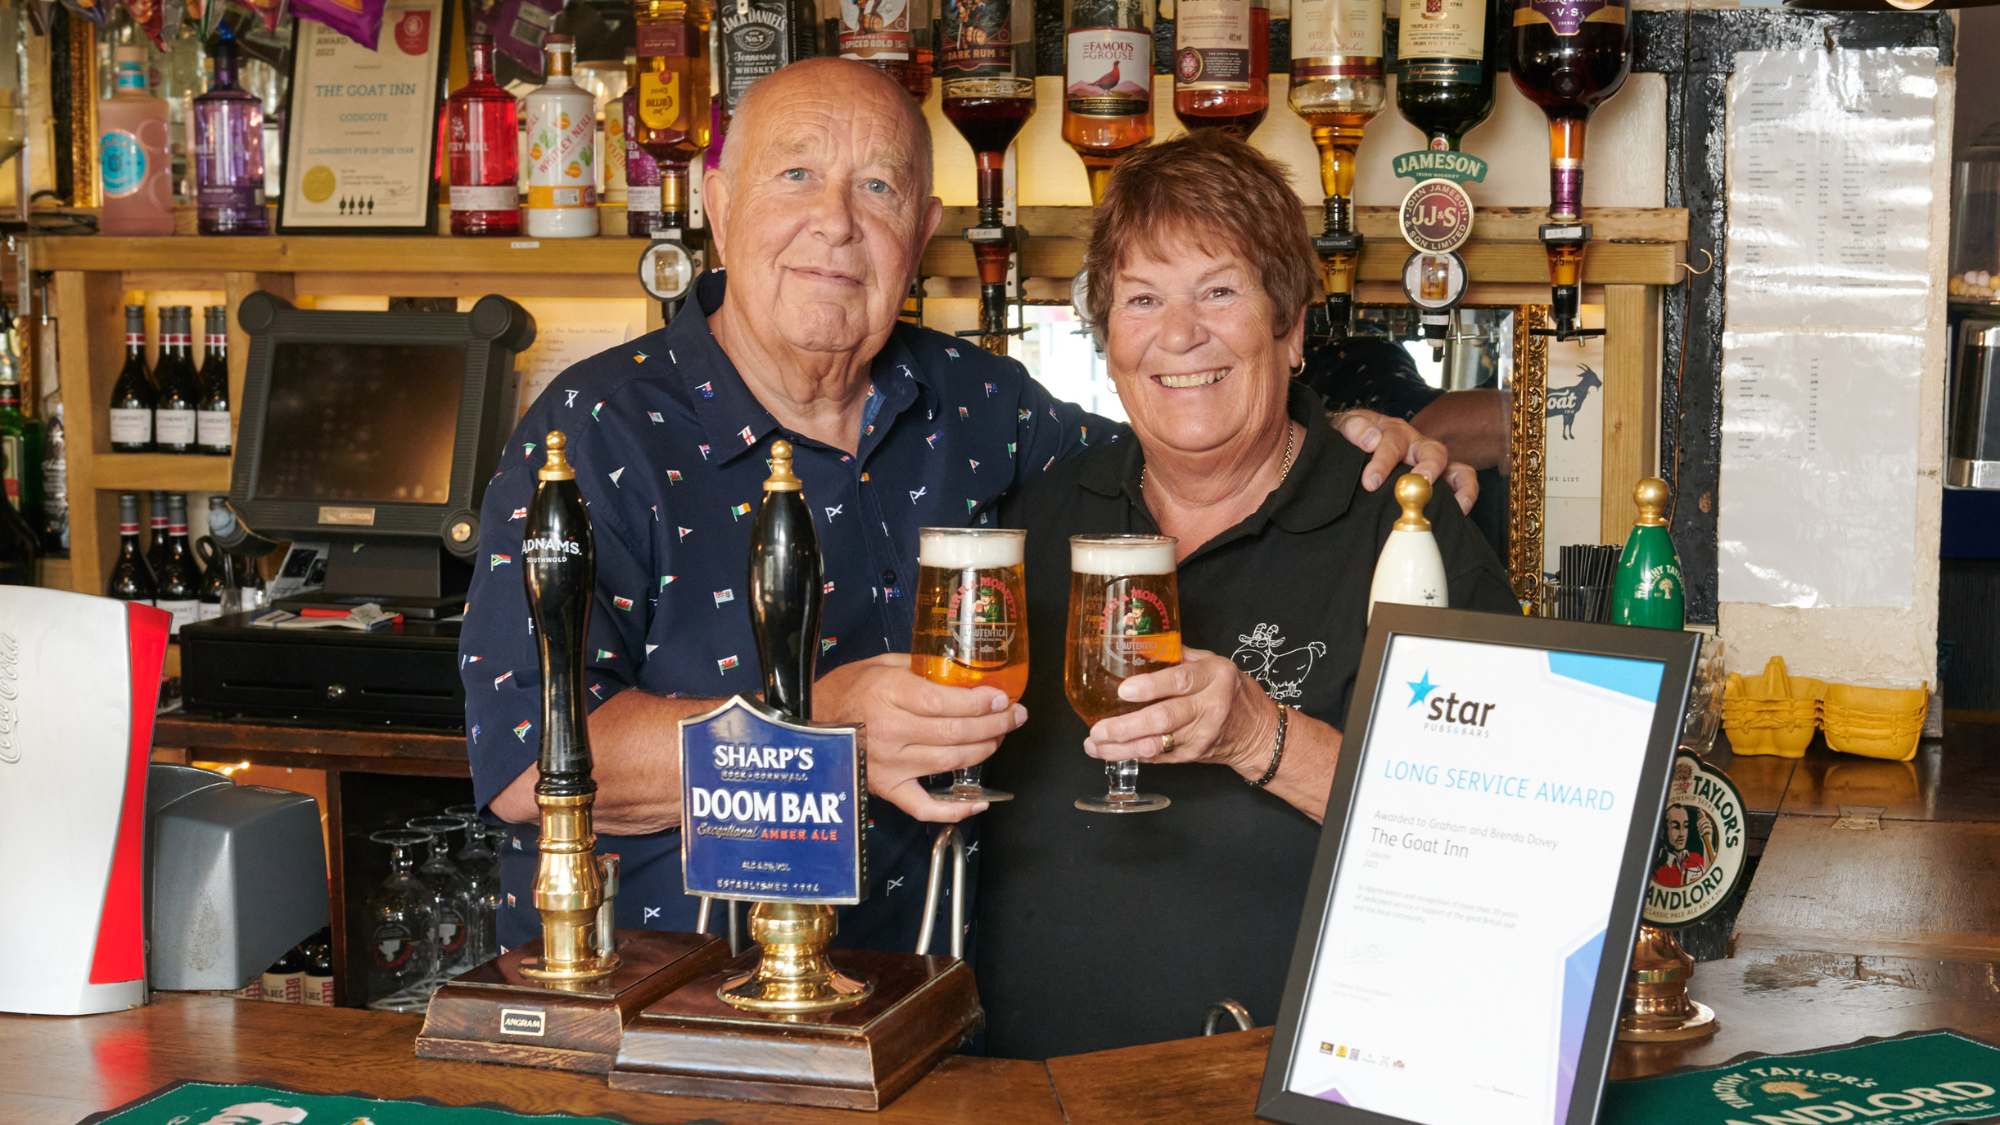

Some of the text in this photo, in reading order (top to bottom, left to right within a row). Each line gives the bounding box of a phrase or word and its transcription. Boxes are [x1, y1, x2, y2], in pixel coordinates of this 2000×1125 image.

[845, 39, 893, 50] SPICED GOLD
[973, 48, 996, 58] RUM
[1090, 41, 1134, 52] FAMOUS
[733, 51, 777, 62] Tennessee
[1089, 51, 1134, 60] GROUSE
[735, 66, 777, 74] WHISKEY
[315, 83, 417, 97] THE GOAT INN
[339, 112, 389, 122] CODICOTE
[538, 114, 592, 174] WHITLEY NEILL
[628, 150, 641, 160] GIN
[1397, 153, 1482, 177] JAMESON
[1405, 187, 1427, 213] JOHN
[1429, 184, 1469, 216] JAMESON
[1411, 204, 1457, 228] JJ&S
[1316, 239, 1348, 247] Beaumont
[1409, 230, 1429, 248] SON
[1431, 223, 1467, 250] LIMITED
[1546, 392, 1578, 410] oat
[526, 556, 568, 564] SOUTHWOLD
[948, 580, 979, 618] BIRRA
[979, 576, 1018, 619] MORETTI
[1099, 589, 1170, 631] BIRRA MORETTI
[1427, 692, 1497, 727] star
[714, 744, 814, 771] SHARP'S
[721, 770, 808, 782] ROCK CORNWALL
[1384, 759, 1615, 811] LONG SERVICE AWARD
[691, 786, 777, 823] DOOM
[1693, 775, 1742, 849] TAYLOR'S
[1697, 797, 1715, 813] BEERS
[697, 821, 838, 841] Exceptional AMBER ALE
[1374, 809, 1560, 851] Awarded to Graham and Brenda Dovey
[1370, 826, 1469, 859] The Goat Inn
[1362, 860, 1379, 869] 2023
[1364, 849, 1391, 861] Codicote
[717, 879, 820, 893] ESTABLISHED 1994
[1645, 866, 1724, 911] ANDLORD
[1352, 903, 1365, 912] and
[1365, 905, 1376, 914] the
[1376, 908, 1391, 917] local
[1364, 885, 1402, 899] appreciation
[1403, 891, 1415, 901] and
[1416, 894, 1450, 908] recognition
[1458, 903, 1475, 911] more
[1476, 904, 1491, 914] than
[1501, 910, 1518, 920] years
[1644, 907, 1669, 919] CLASSIC
[1670, 911, 1685, 919] PALE
[1686, 907, 1698, 916] ALE
[1699, 900, 1710, 910] ABV
[1362, 895, 1392, 907] dedicated
[1393, 901, 1414, 911] service
[1421, 906, 1445, 918] support
[1453, 911, 1464, 920] the
[1464, 914, 1482, 924] great
[1482, 916, 1503, 928] British
[1503, 920, 1517, 930] pub
[504, 1017, 540, 1028] ANGRAM
[1712, 1072, 1755, 1109] TIMOTHY
[1749, 1066, 1880, 1089] TAYLOR'S
[1897, 1100, 1996, 1123] PALE ALE
